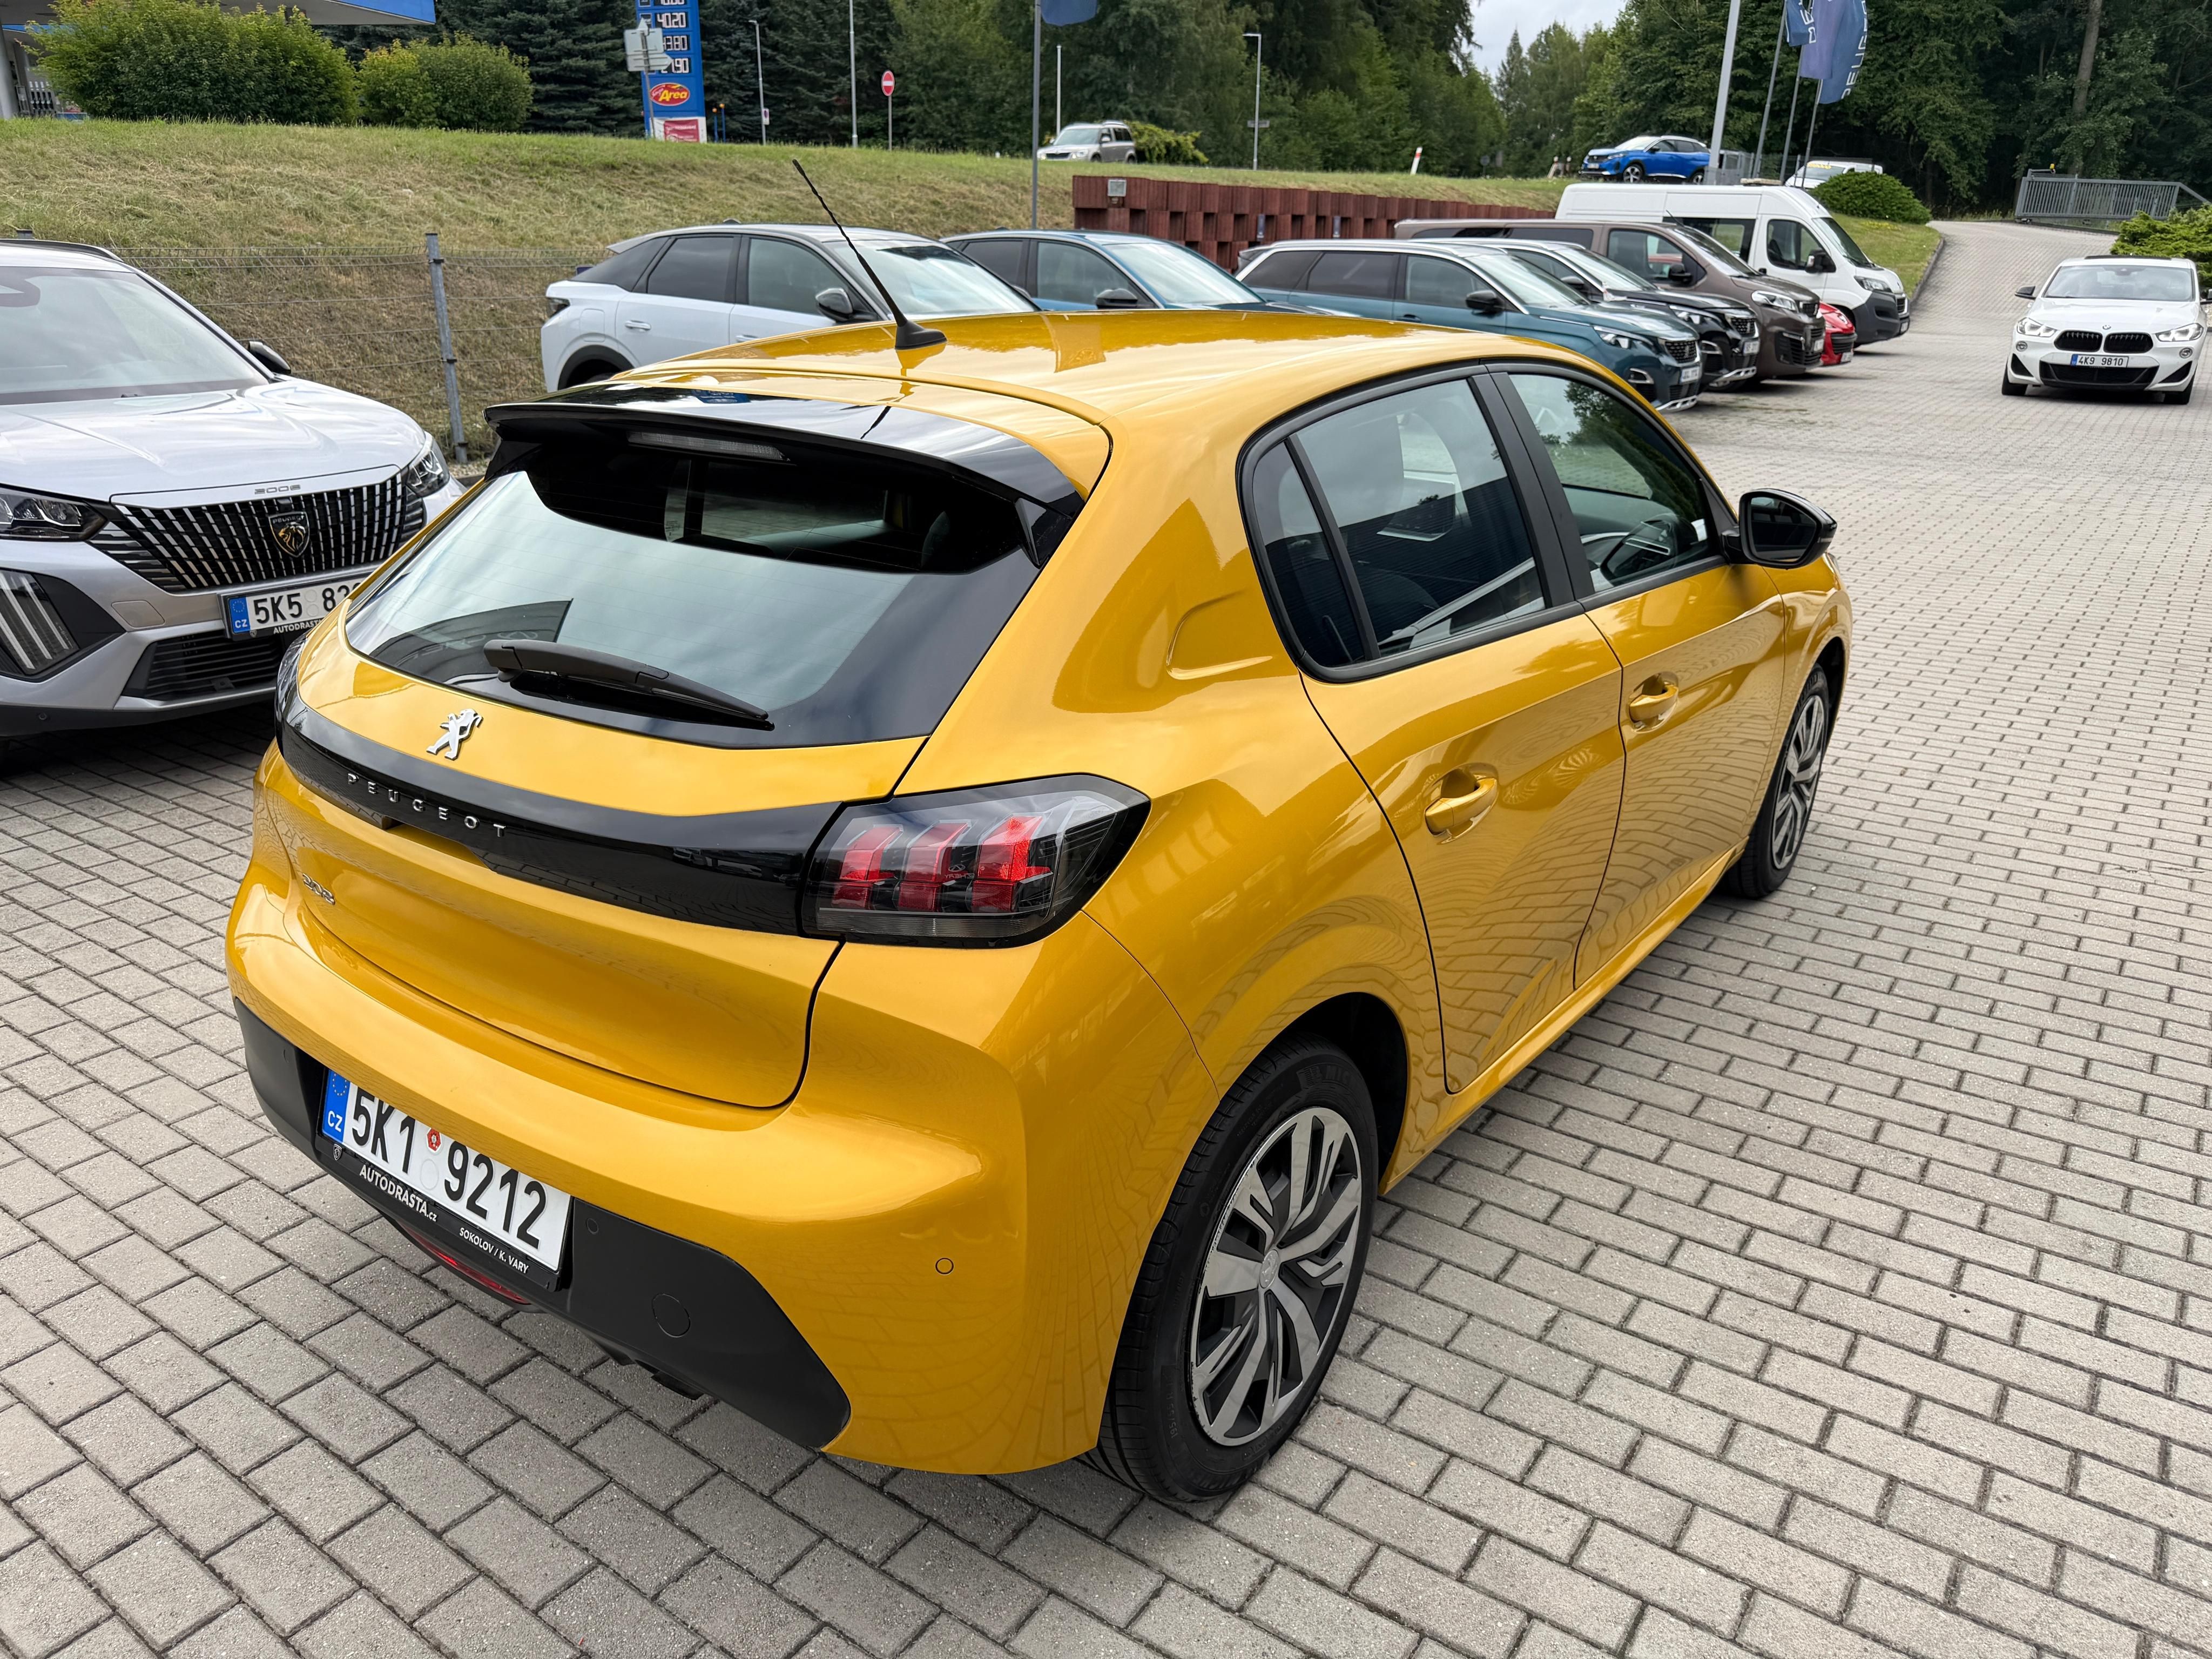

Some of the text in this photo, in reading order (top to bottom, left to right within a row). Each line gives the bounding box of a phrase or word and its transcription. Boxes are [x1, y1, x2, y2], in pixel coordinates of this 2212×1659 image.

[658, 90, 687, 102] Area
[2079, 356, 2123, 366] 4K9 9810
[253, 592, 302, 624] 5K5
[234, 619, 248, 629] CZ
[273, 619, 322, 635] AUTODRAST
[348, 773, 506, 837] PEUGEOT
[302, 873, 335, 905] 208
[327, 1110, 343, 1132] CZ
[352, 1087, 547, 1249] 5K1 9212
[460, 1227, 495, 1253] SOKOLOV
[499, 1250, 507, 1262] K.
[509, 1255, 529, 1273] VARY
